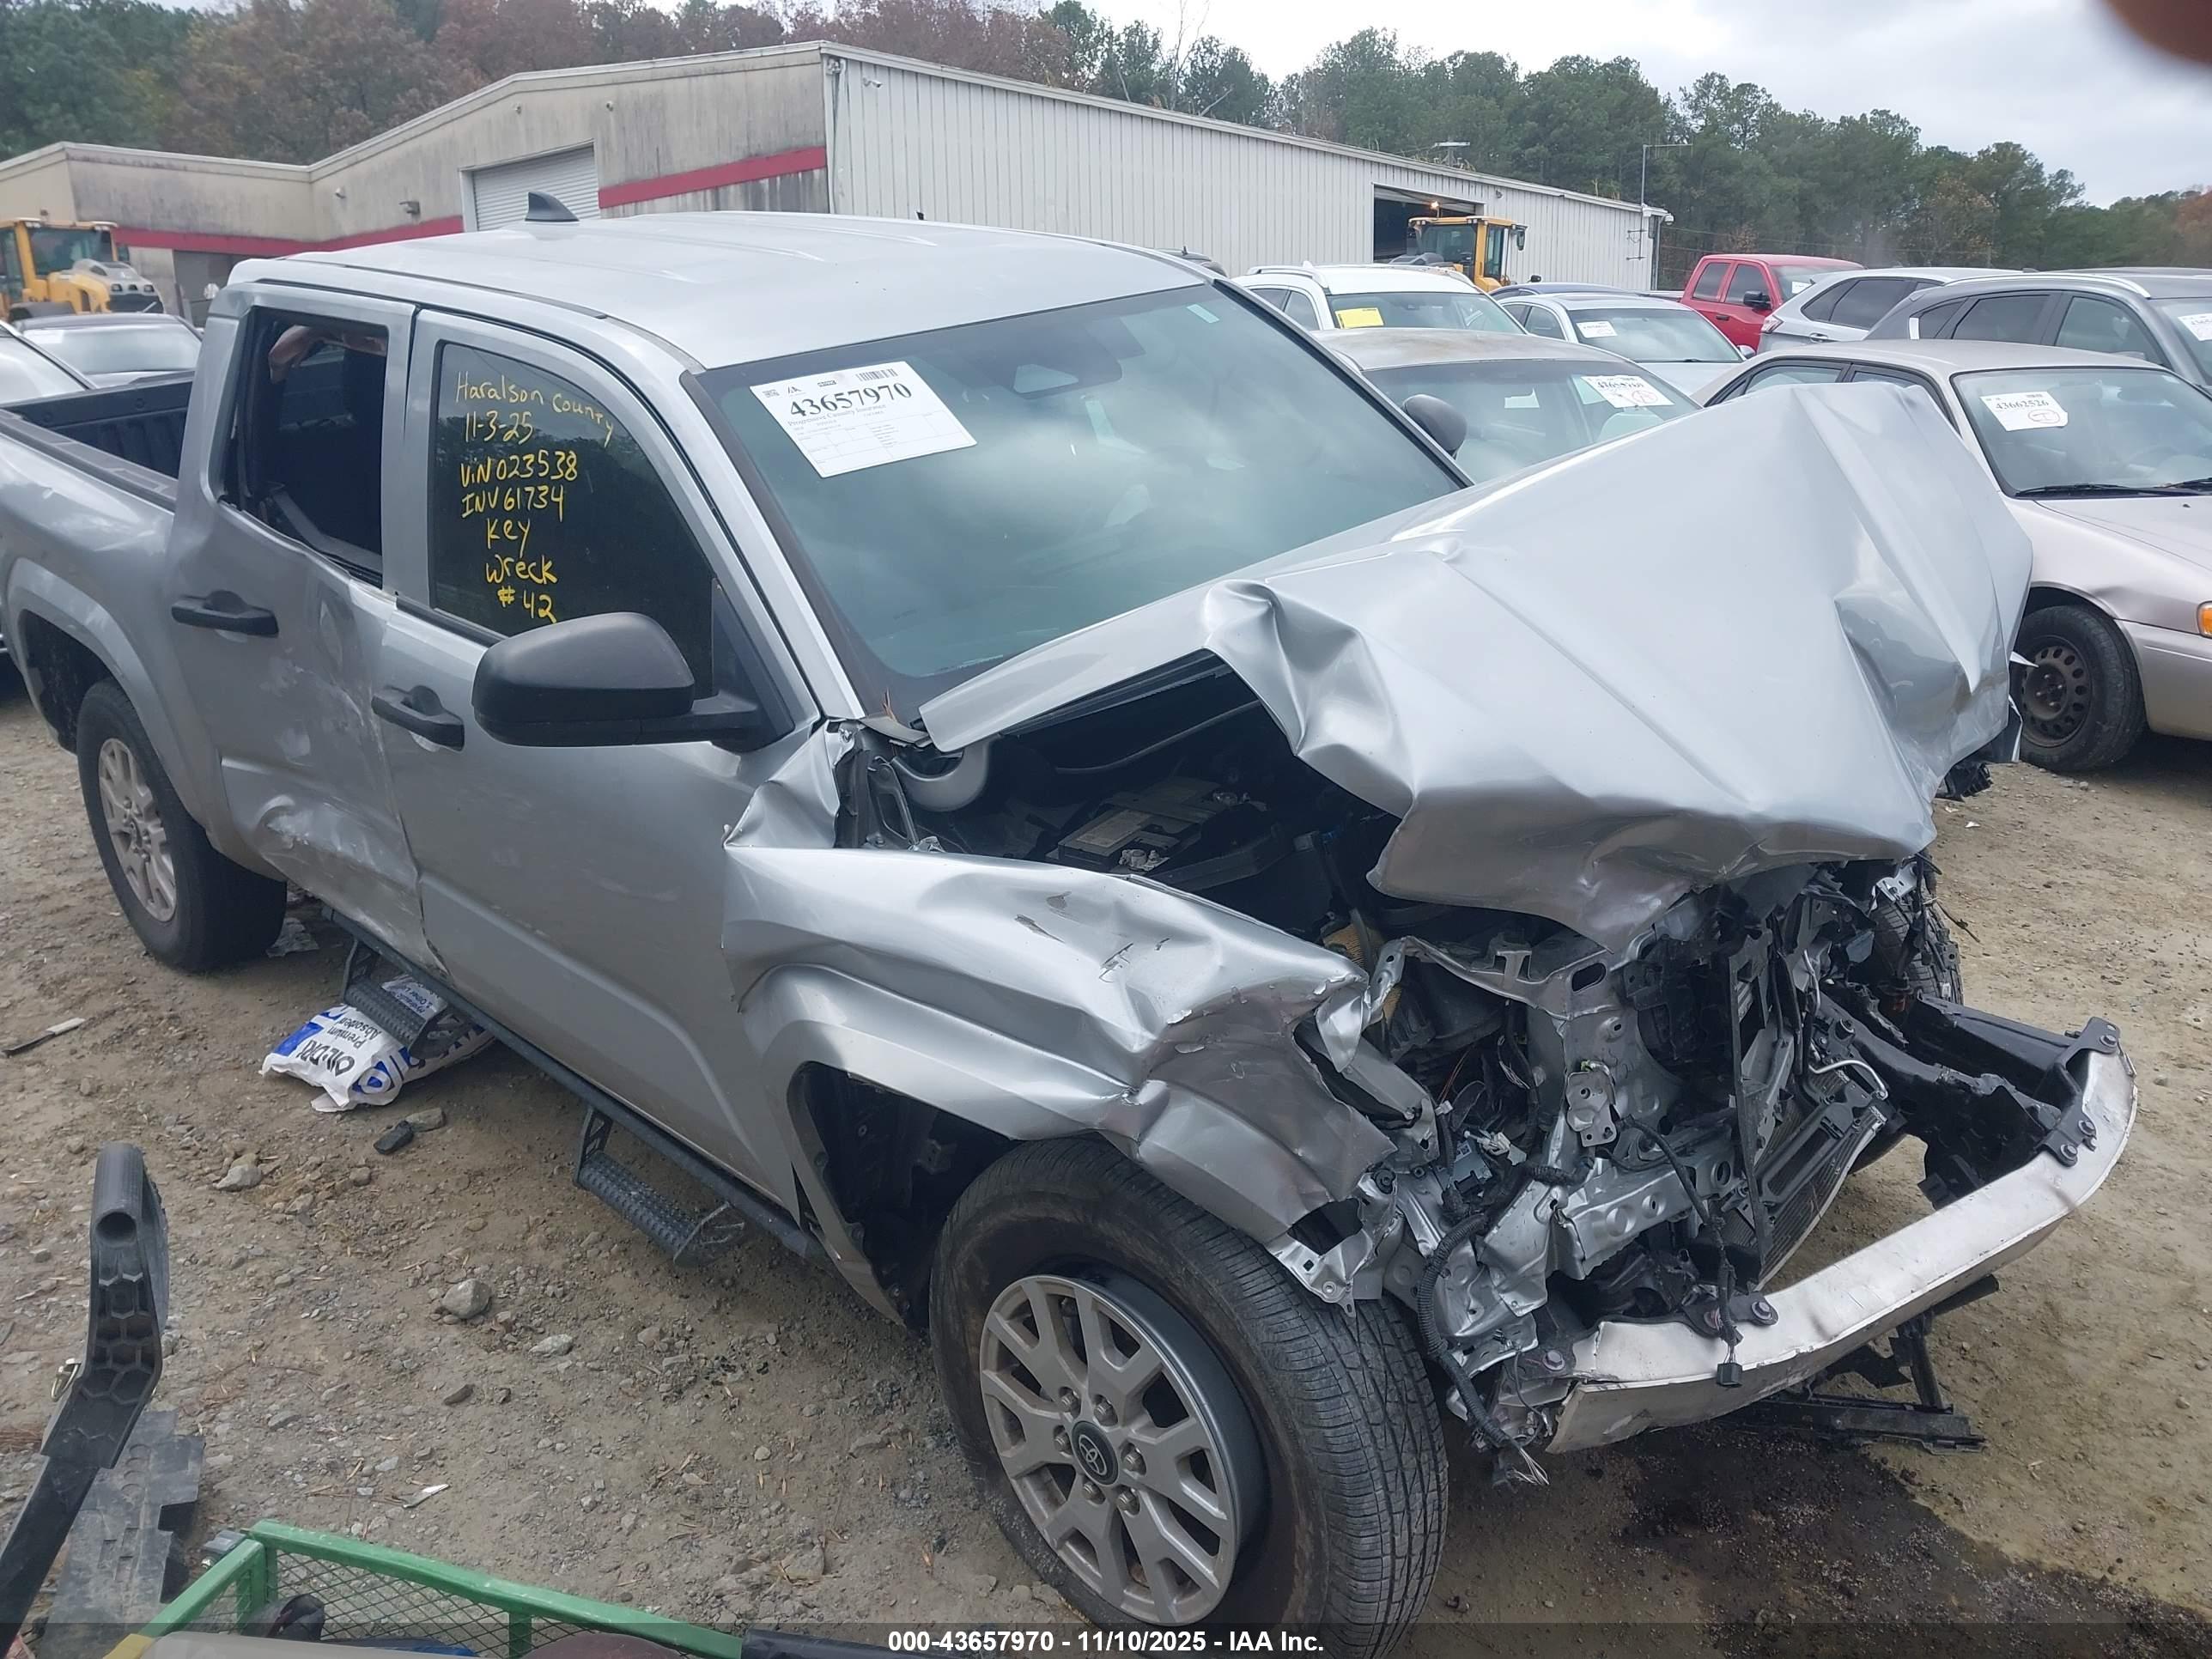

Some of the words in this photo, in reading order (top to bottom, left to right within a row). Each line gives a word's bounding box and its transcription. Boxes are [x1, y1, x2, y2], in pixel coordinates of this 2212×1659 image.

[456, 371, 544, 405] Haralson
[552, 392, 613, 447] County
[790, 382, 912, 416] 43657970
[465, 410, 533, 445] 11-3-25
[495, 449, 578, 481] 023538
[461, 486, 500, 518] INV
[503, 484, 564, 522] 61734
[496, 586, 516, 607] #
[522, 590, 557, 624] 42
[327, 1025, 366, 1049] Premium
